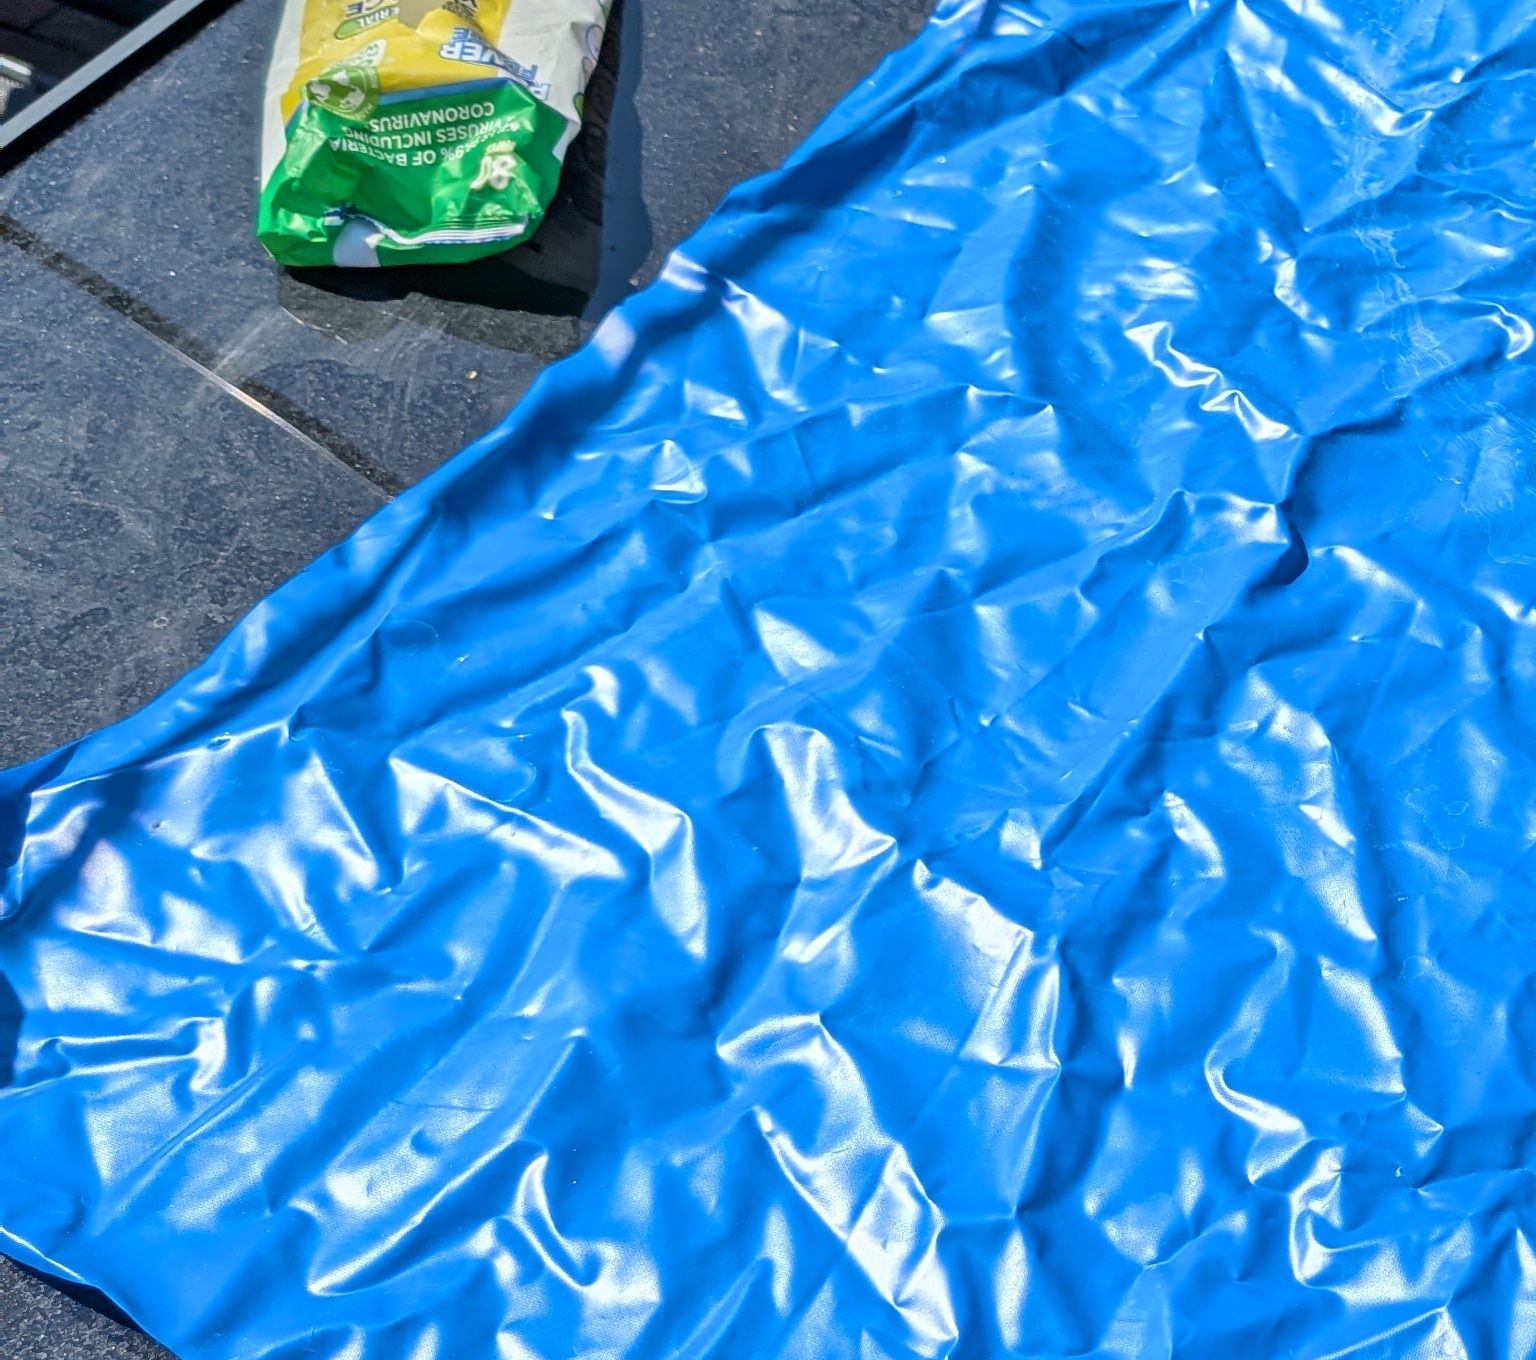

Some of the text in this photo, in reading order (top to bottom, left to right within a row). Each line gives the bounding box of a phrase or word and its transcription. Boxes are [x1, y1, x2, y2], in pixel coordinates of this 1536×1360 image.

[342, 126, 432, 148] INCLUDING
[436, 120, 503, 142] VIRUSES
[329, 138, 437, 167] OF BACTERIA
